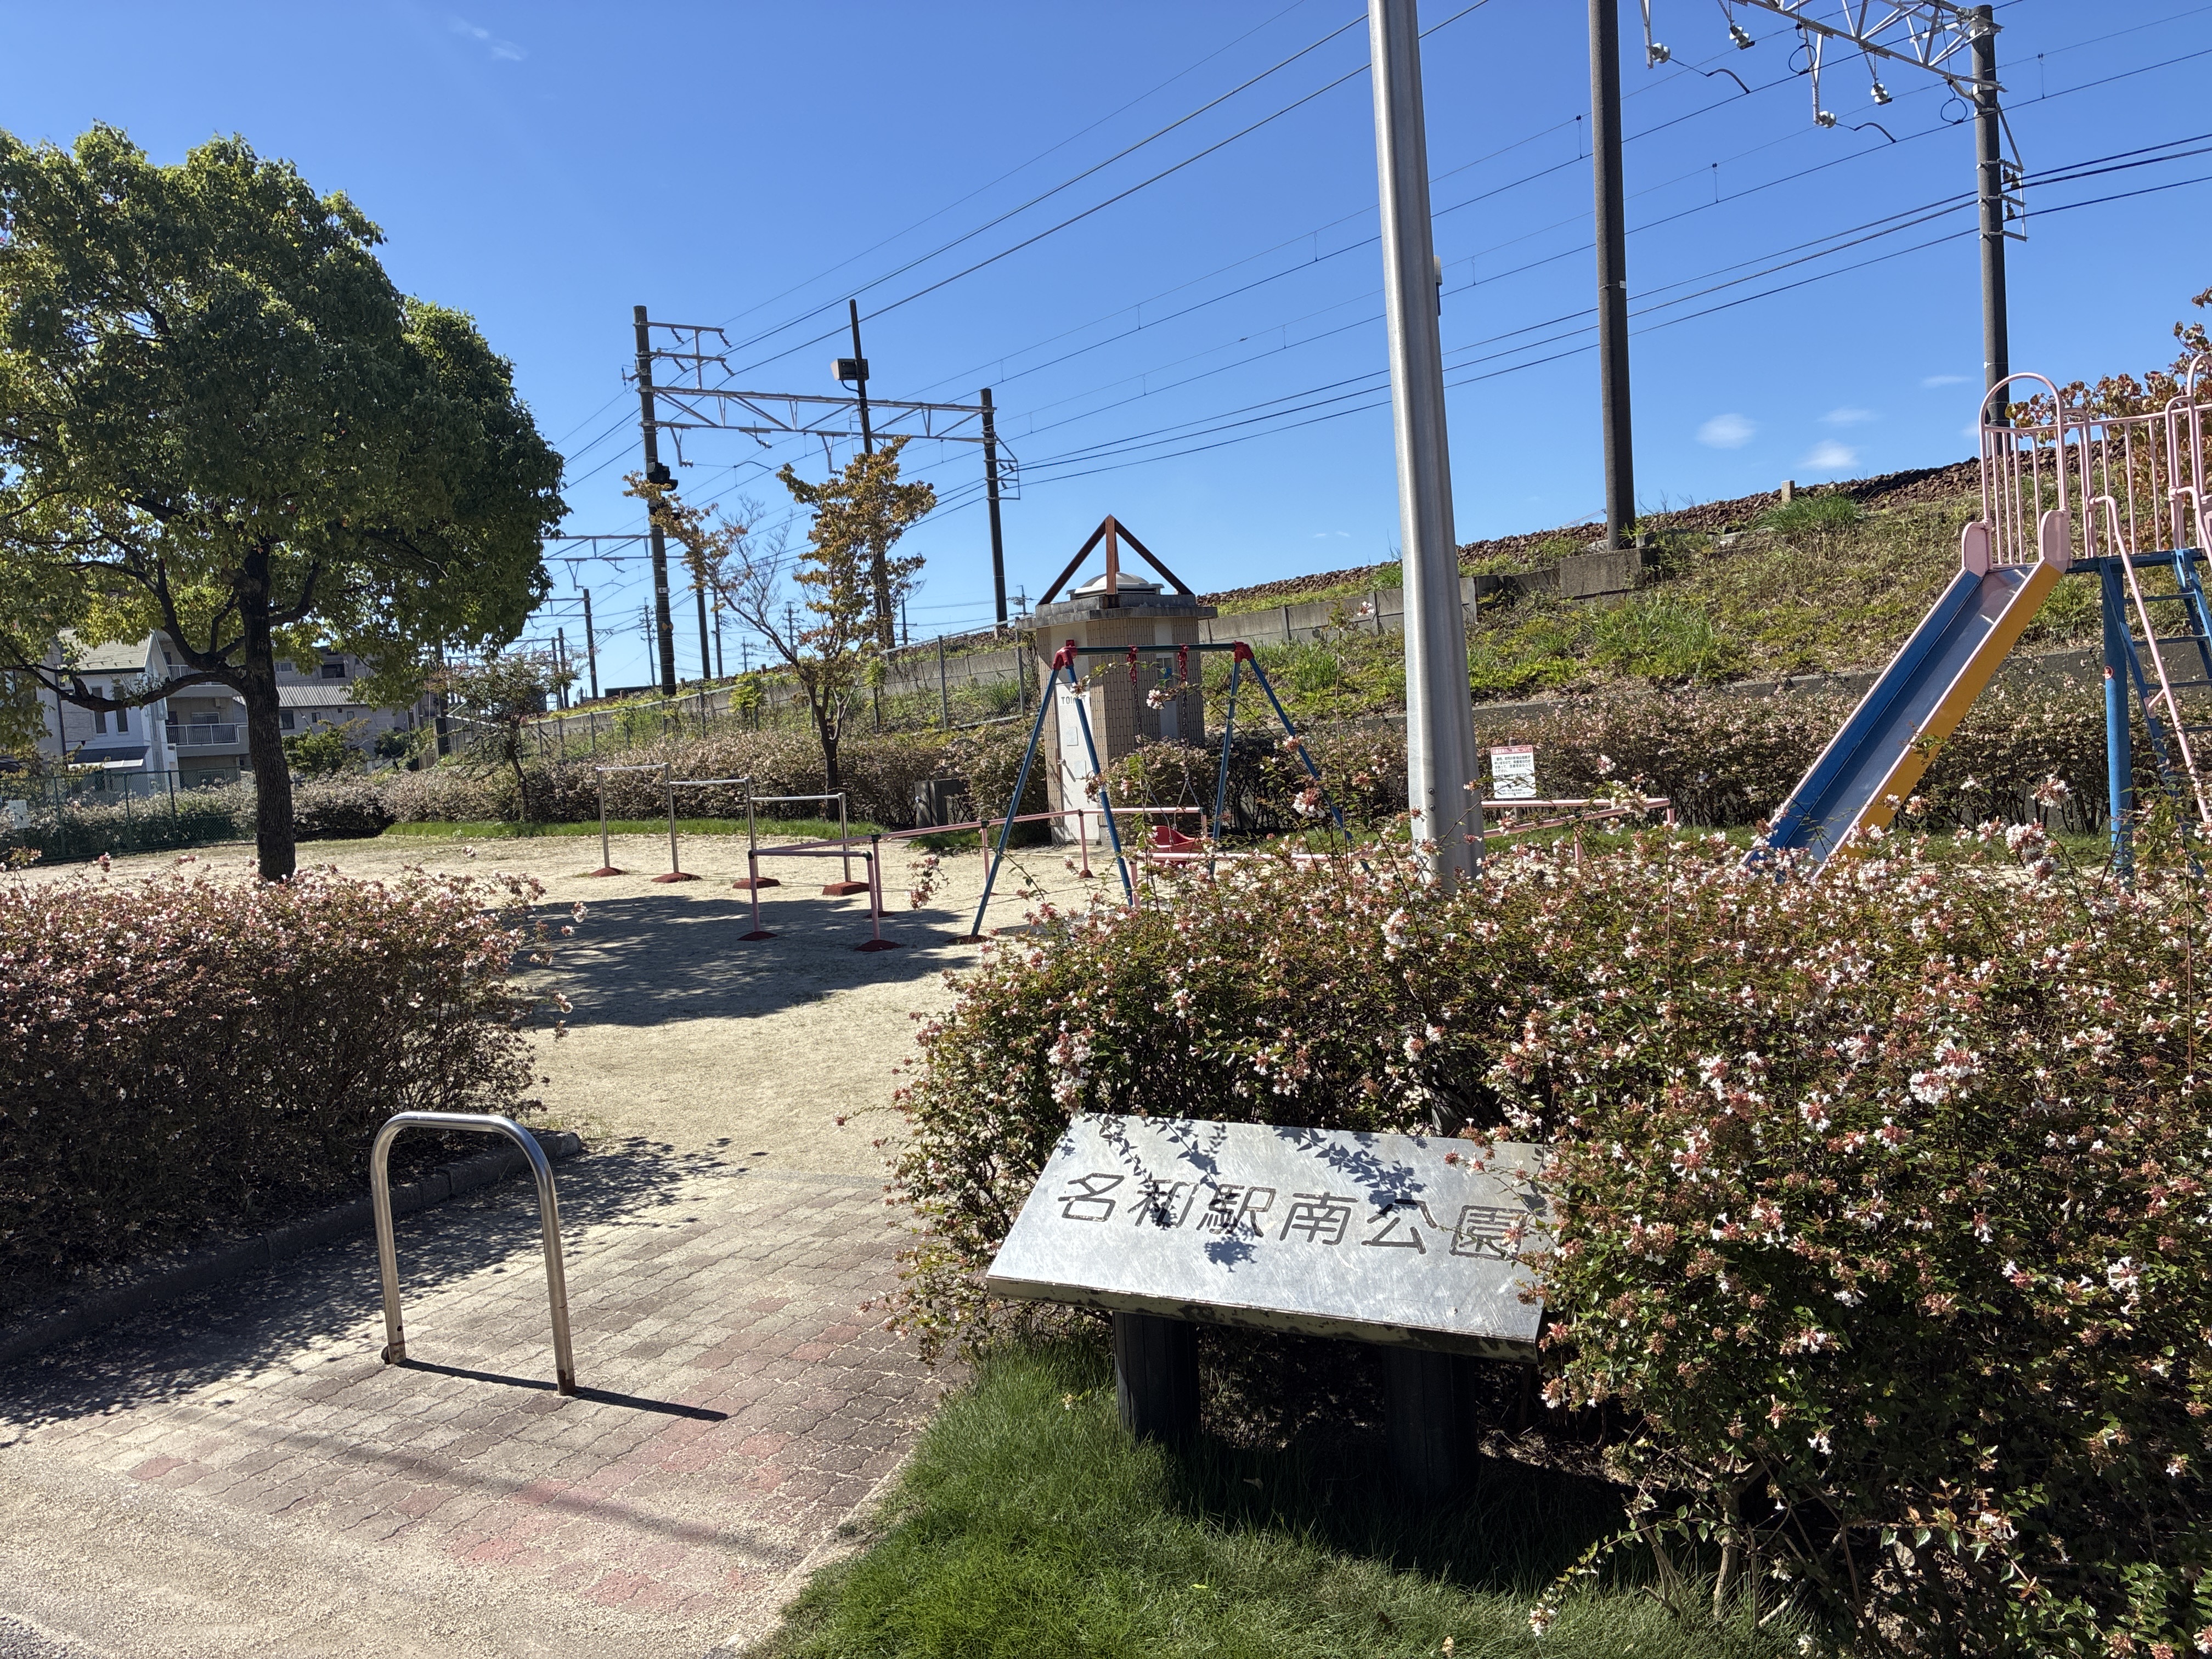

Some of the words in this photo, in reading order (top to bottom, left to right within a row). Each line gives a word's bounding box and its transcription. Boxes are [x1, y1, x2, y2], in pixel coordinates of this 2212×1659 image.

[1060, 695, 1086, 704] TOIT
[1058, 1172, 1530, 1261] 名和駅南公園
